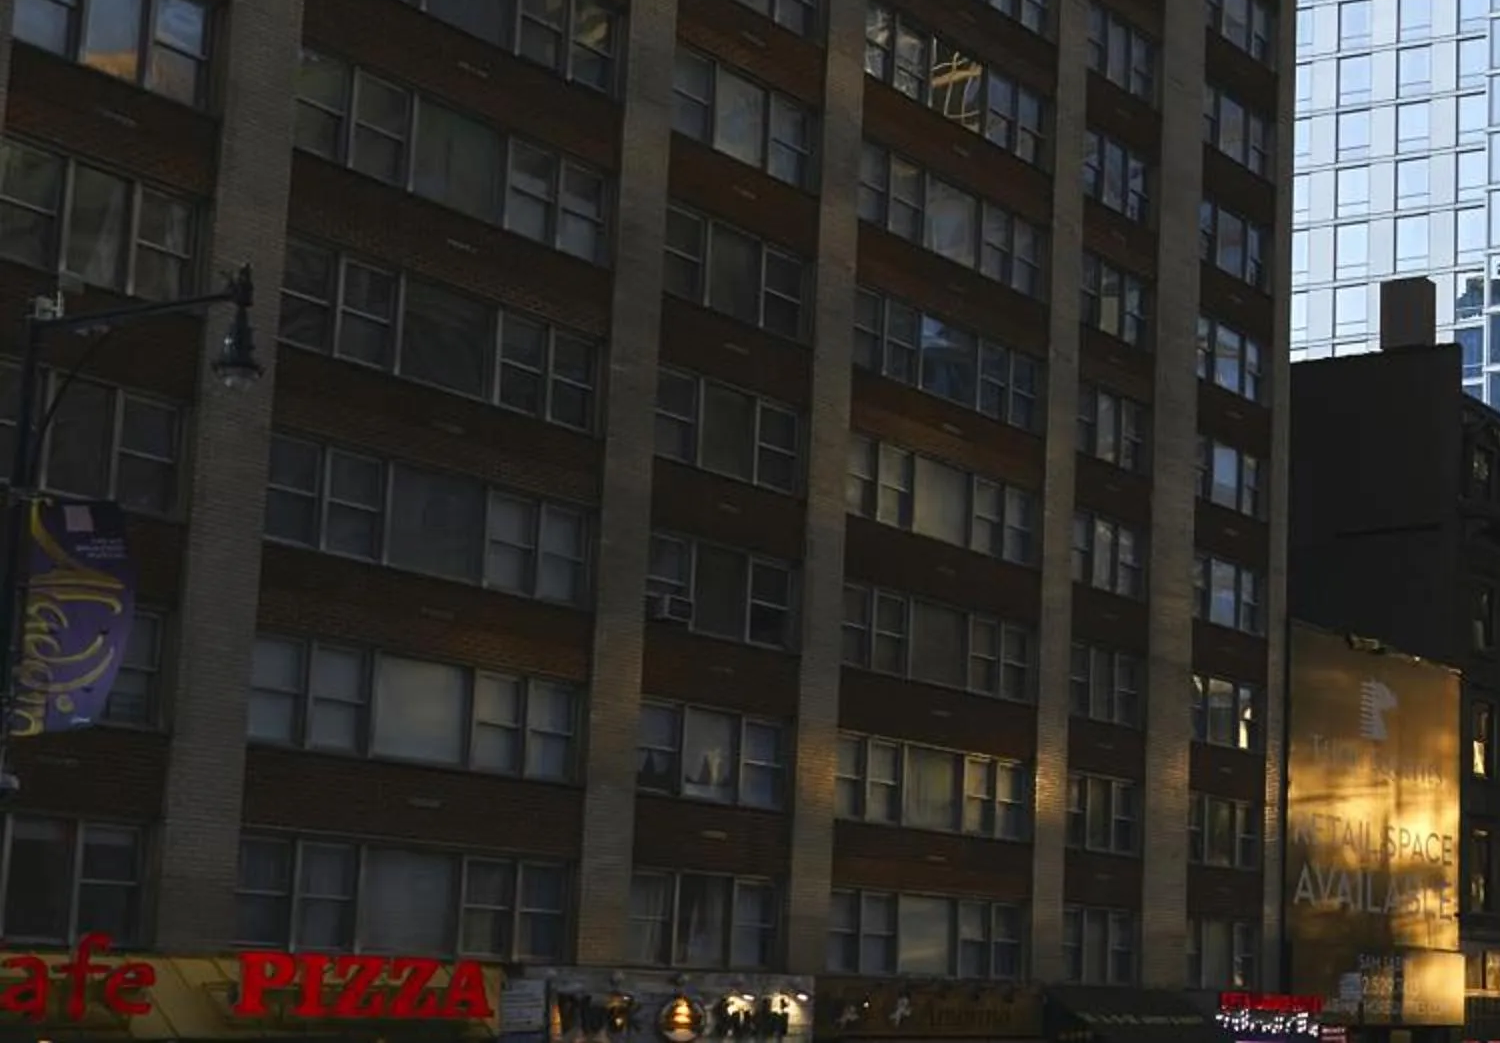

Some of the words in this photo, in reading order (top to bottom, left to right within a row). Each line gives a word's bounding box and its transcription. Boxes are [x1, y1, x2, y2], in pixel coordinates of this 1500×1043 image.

[1293, 812, 1378, 855] RETAIL
[1380, 823, 1453, 866] SPACE
[1293, 862, 1453, 921] AVAILABLE
[232, 950, 494, 1019] PIZZA
